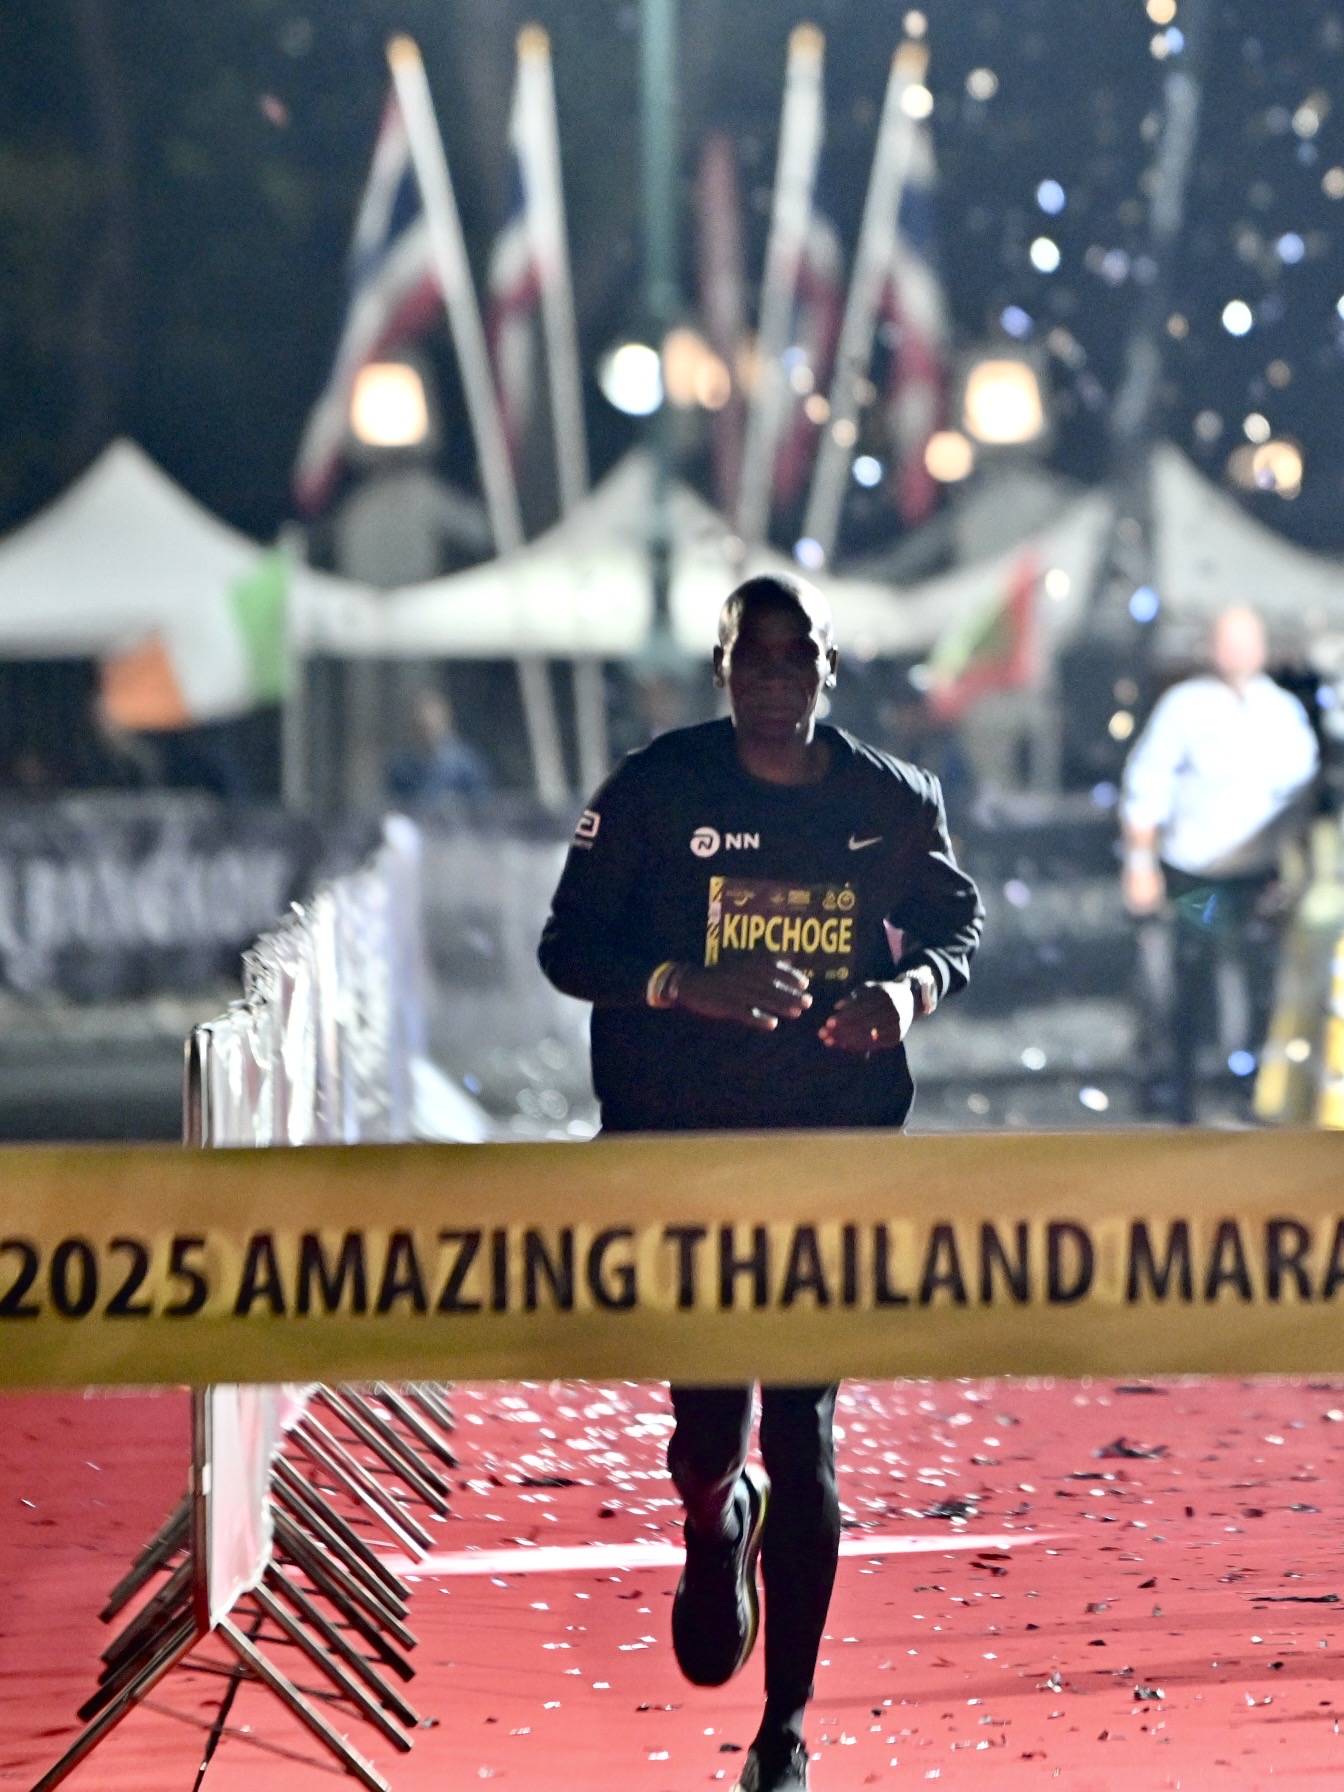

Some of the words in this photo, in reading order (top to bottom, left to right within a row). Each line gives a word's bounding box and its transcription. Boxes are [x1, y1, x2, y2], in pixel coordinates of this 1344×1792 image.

[725, 831, 761, 851] NN
[722, 912, 854, 955] KIPCHOGE
[0, 1235, 210, 1322] 2025
[230, 1227, 638, 1318] AMAZING
[664, 1222, 1094, 1311] THAILAND
